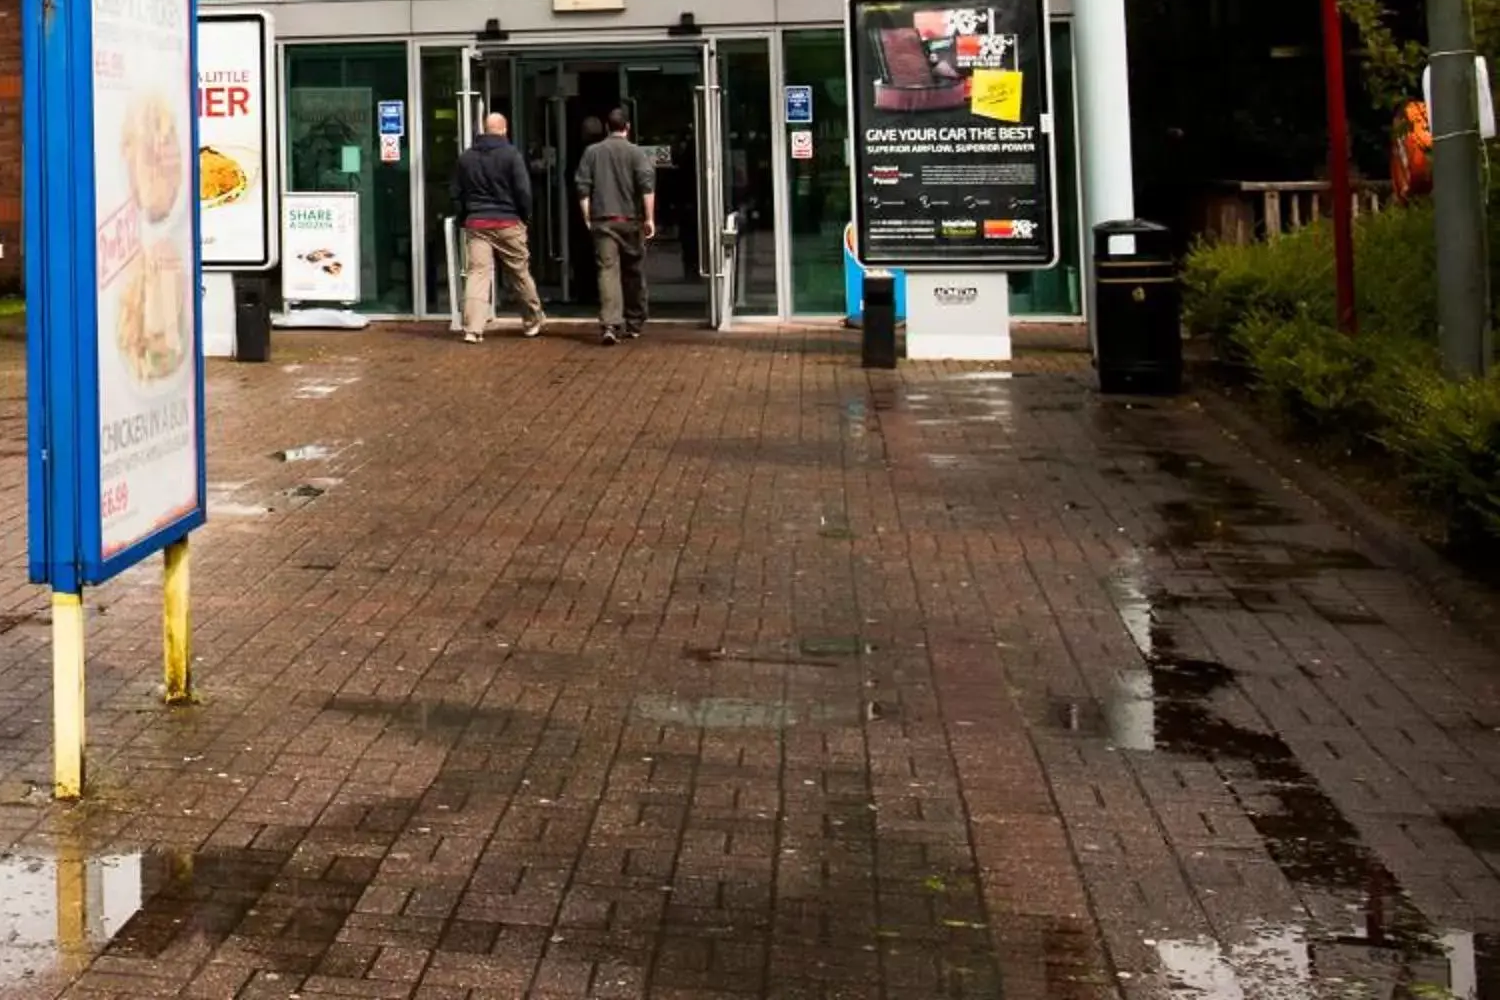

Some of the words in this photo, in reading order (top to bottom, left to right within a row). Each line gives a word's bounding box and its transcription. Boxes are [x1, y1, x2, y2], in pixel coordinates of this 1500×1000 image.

[205, 71, 249, 83] LITTLE
[866, 128, 897, 141] GIVE
[898, 128, 937, 141] YOUR
[939, 127, 967, 141] CAR
[968, 127, 997, 140] THE
[999, 126, 1035, 140] BEST
[955, 143, 1000, 153] SUPERIOR
[1001, 143, 1035, 152] POWER
[289, 209, 333, 220] SHARE
